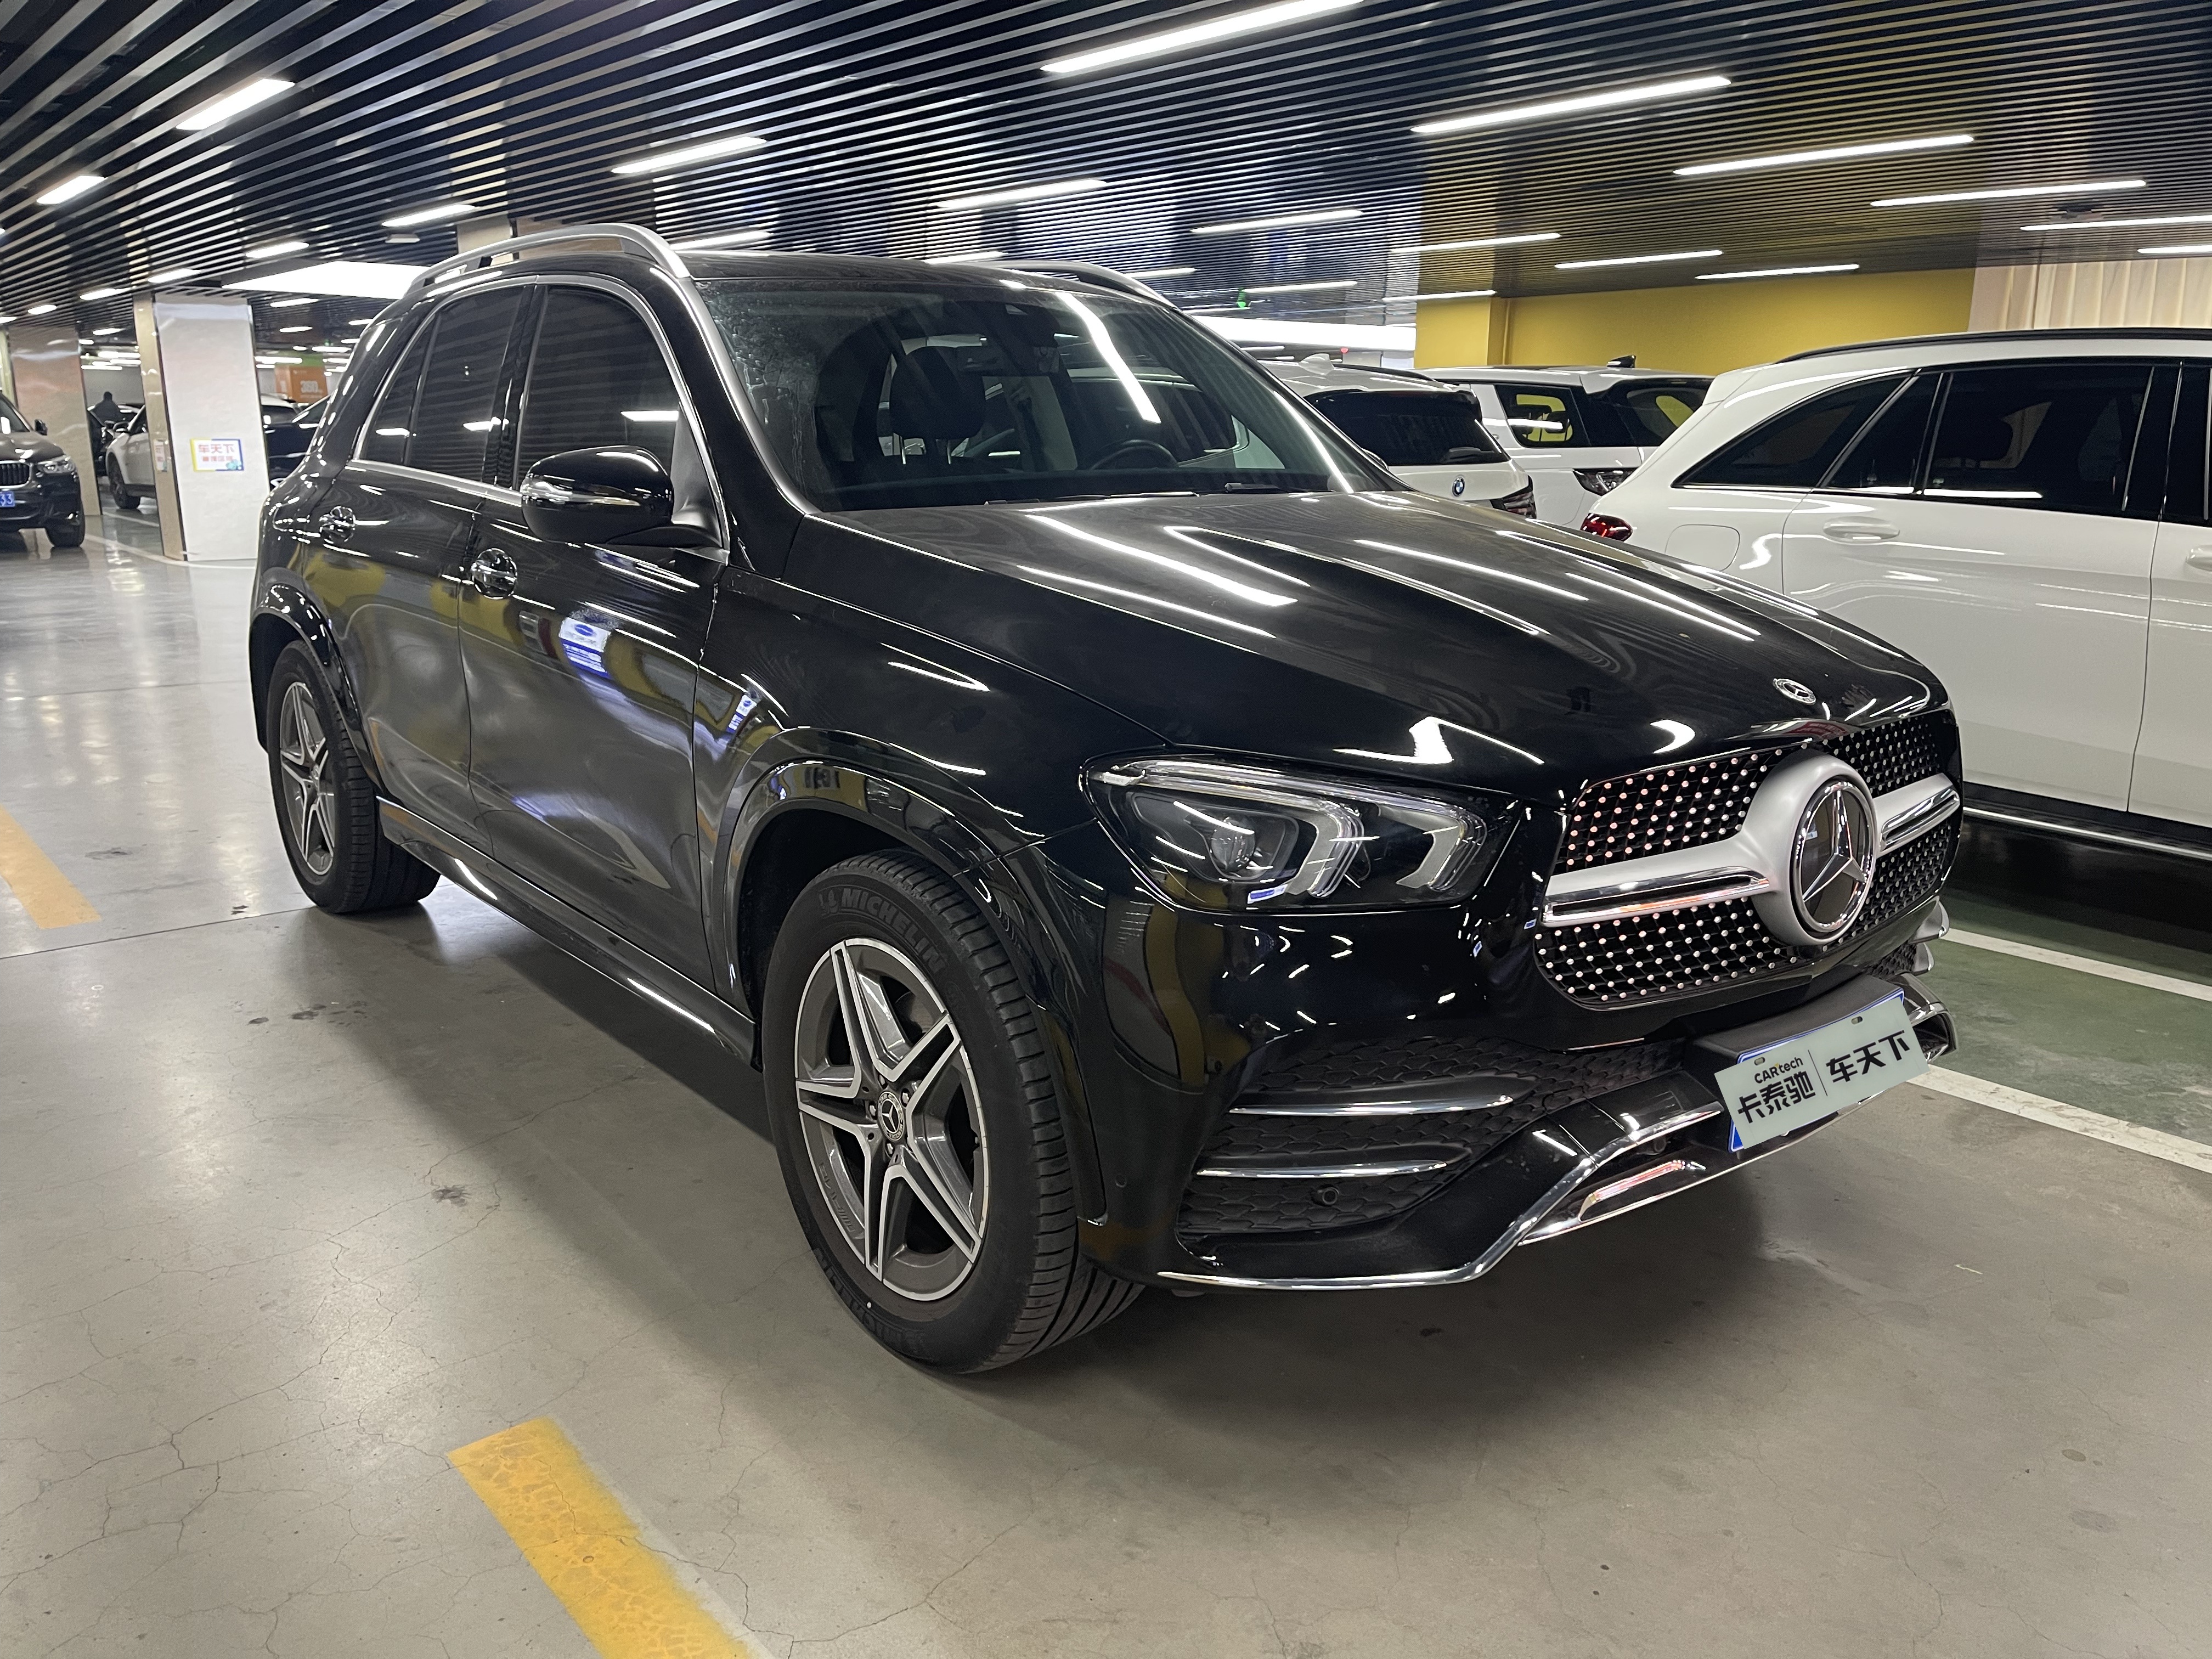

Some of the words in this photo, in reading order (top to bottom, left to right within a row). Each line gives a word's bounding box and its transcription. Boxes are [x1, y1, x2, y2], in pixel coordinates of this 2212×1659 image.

[198, 443, 235, 454] 车天下
[842, 888, 946, 973] MICHELIN
[1737, 1070, 1815, 1124] 卡泰驰
[1826, 1030, 1910, 1082] 车天下
[1754, 1057, 1804, 1084] CARtech
